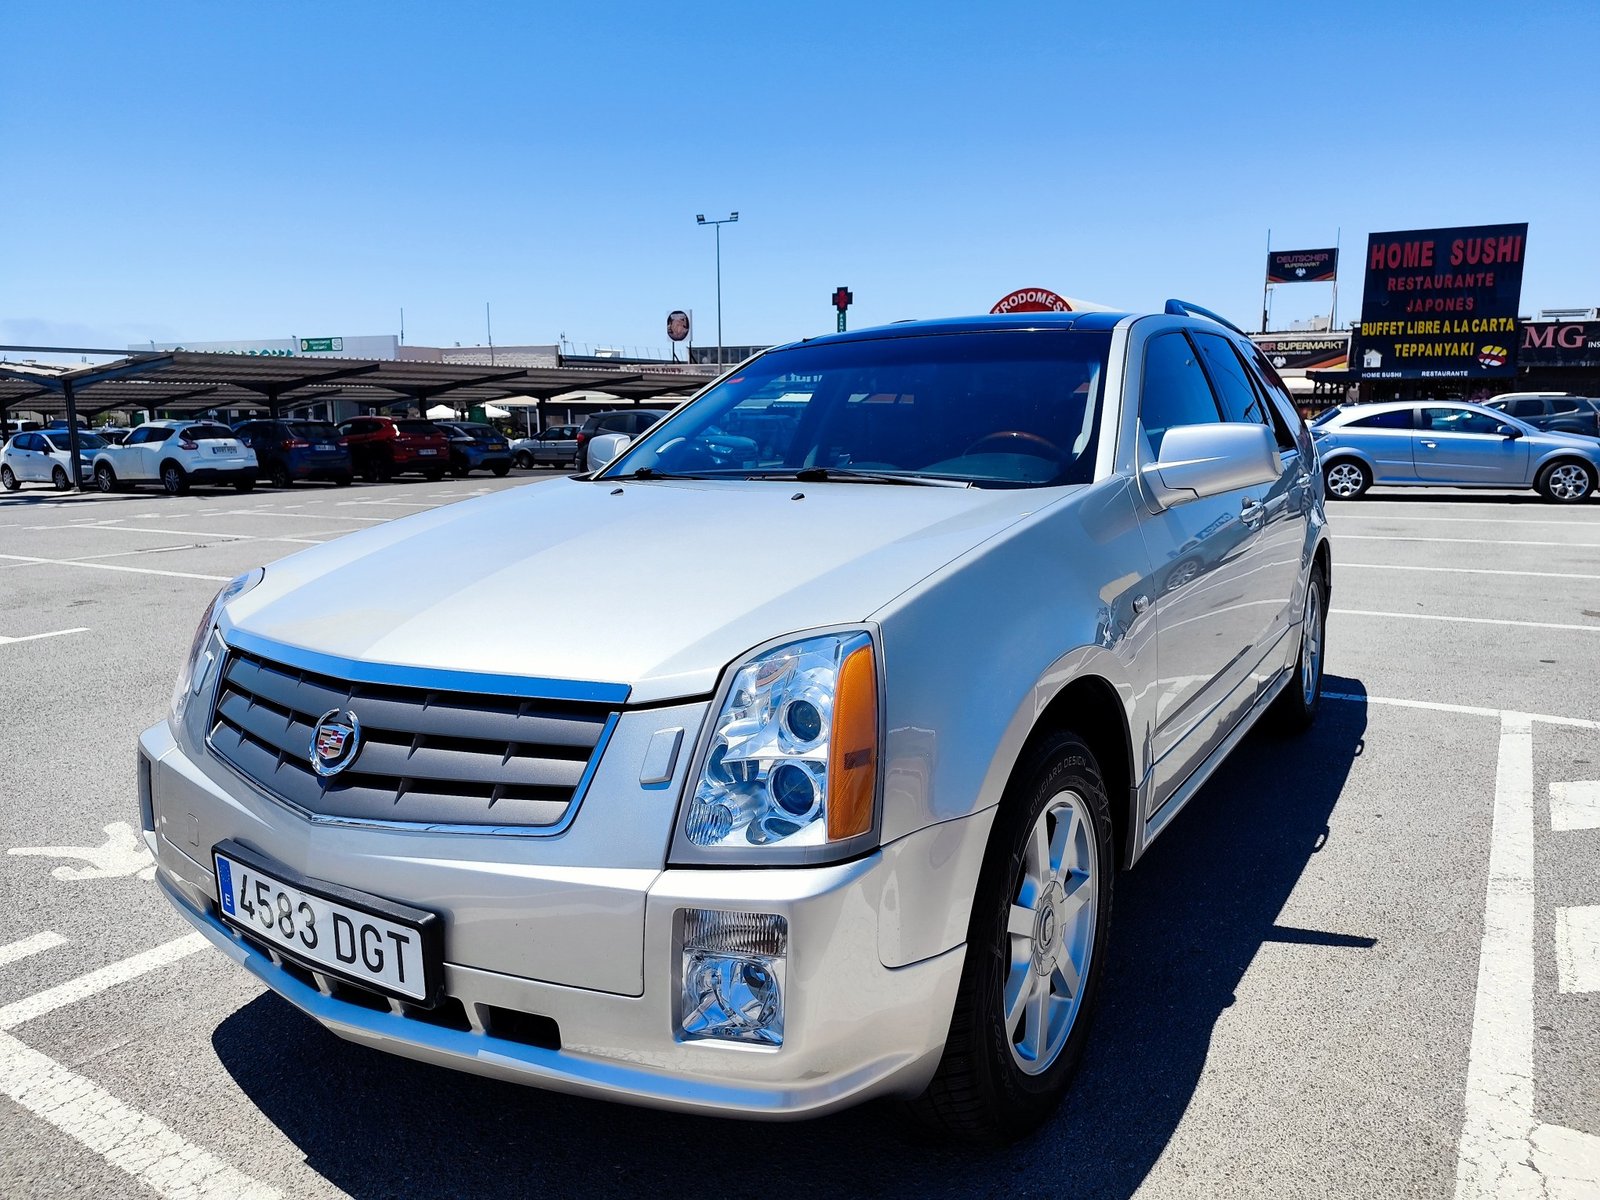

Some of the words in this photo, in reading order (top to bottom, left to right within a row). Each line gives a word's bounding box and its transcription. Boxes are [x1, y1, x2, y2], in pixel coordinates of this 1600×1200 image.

[1276, 253, 1329, 263] DEUTSCHER
[1371, 241, 1434, 269] HOME
[1451, 236, 1521, 266] SUSHI
[1387, 272, 1494, 291] RESTAURANTE
[1406, 297, 1474, 313] JAPONES
[1361, 321, 1404, 336] BUFFET
[1407, 320, 1441, 335] LIBRE
[1443, 320, 1451, 334] A
[1453, 319, 1469, 333] LA
[1471, 317, 1515, 333] CARTA
[1276, 341, 1344, 351] SUPERMARKT
[1521, 325, 1587, 349] MG
[1394, 342, 1475, 357] TEPPANYAKI
[224, 893, 231, 906] E
[239, 873, 318, 950] 4583
[332, 911, 410, 984] DGT
